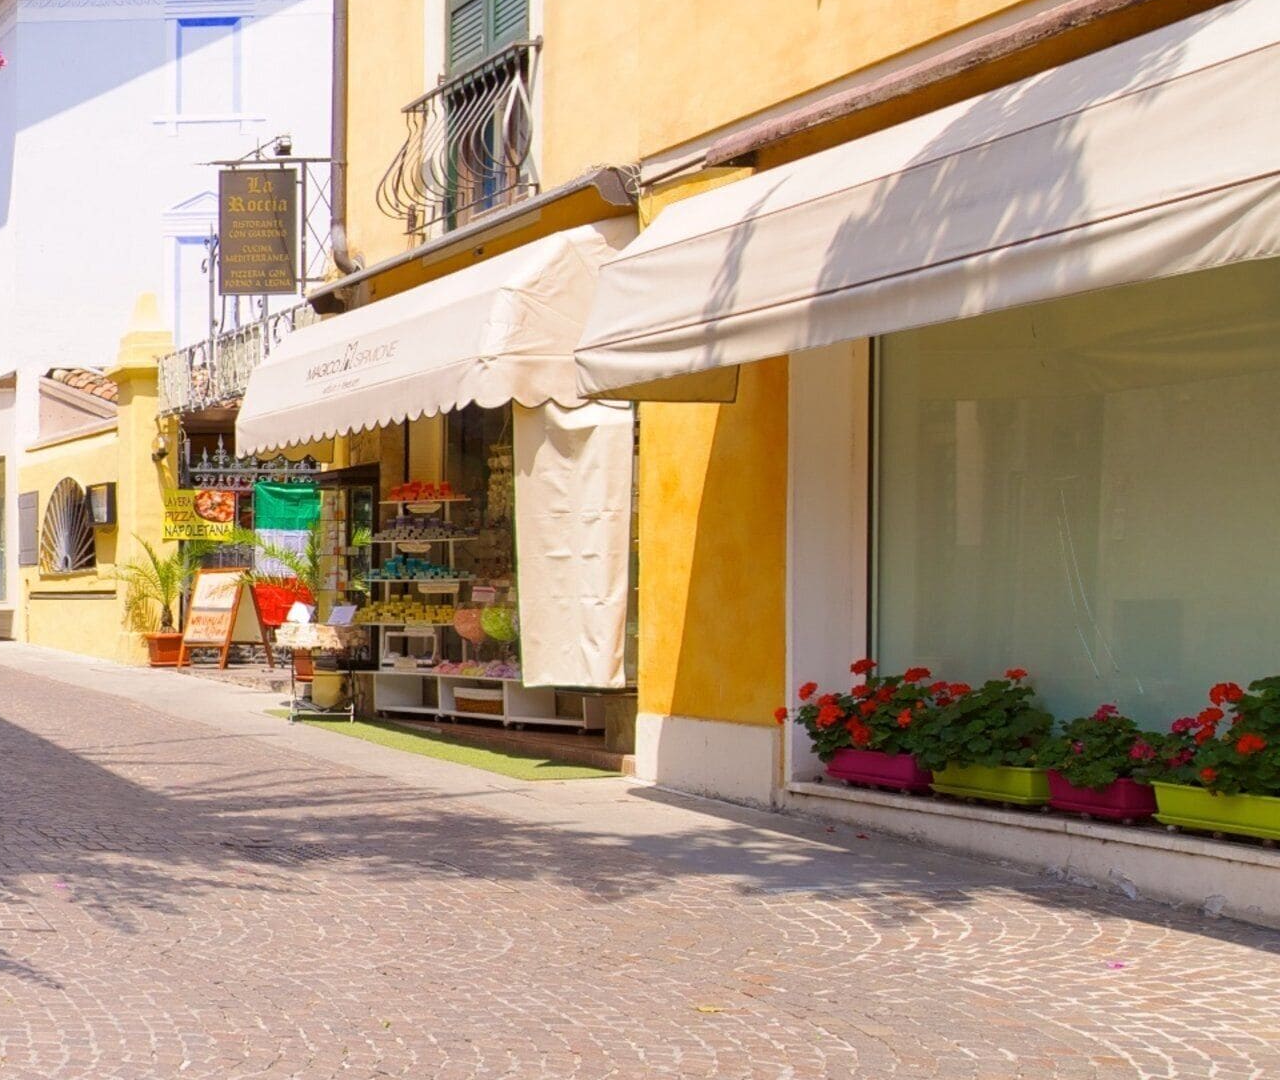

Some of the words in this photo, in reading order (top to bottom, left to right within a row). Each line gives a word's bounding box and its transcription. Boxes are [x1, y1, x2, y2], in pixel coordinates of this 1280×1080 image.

[247, 176, 273, 194] La
[228, 196, 288, 212] Roccia
[230, 270, 266, 278] PIZZERIA
[165, 511, 196, 521] PIZZA
[165, 524, 230, 537] NAPOLETANA
